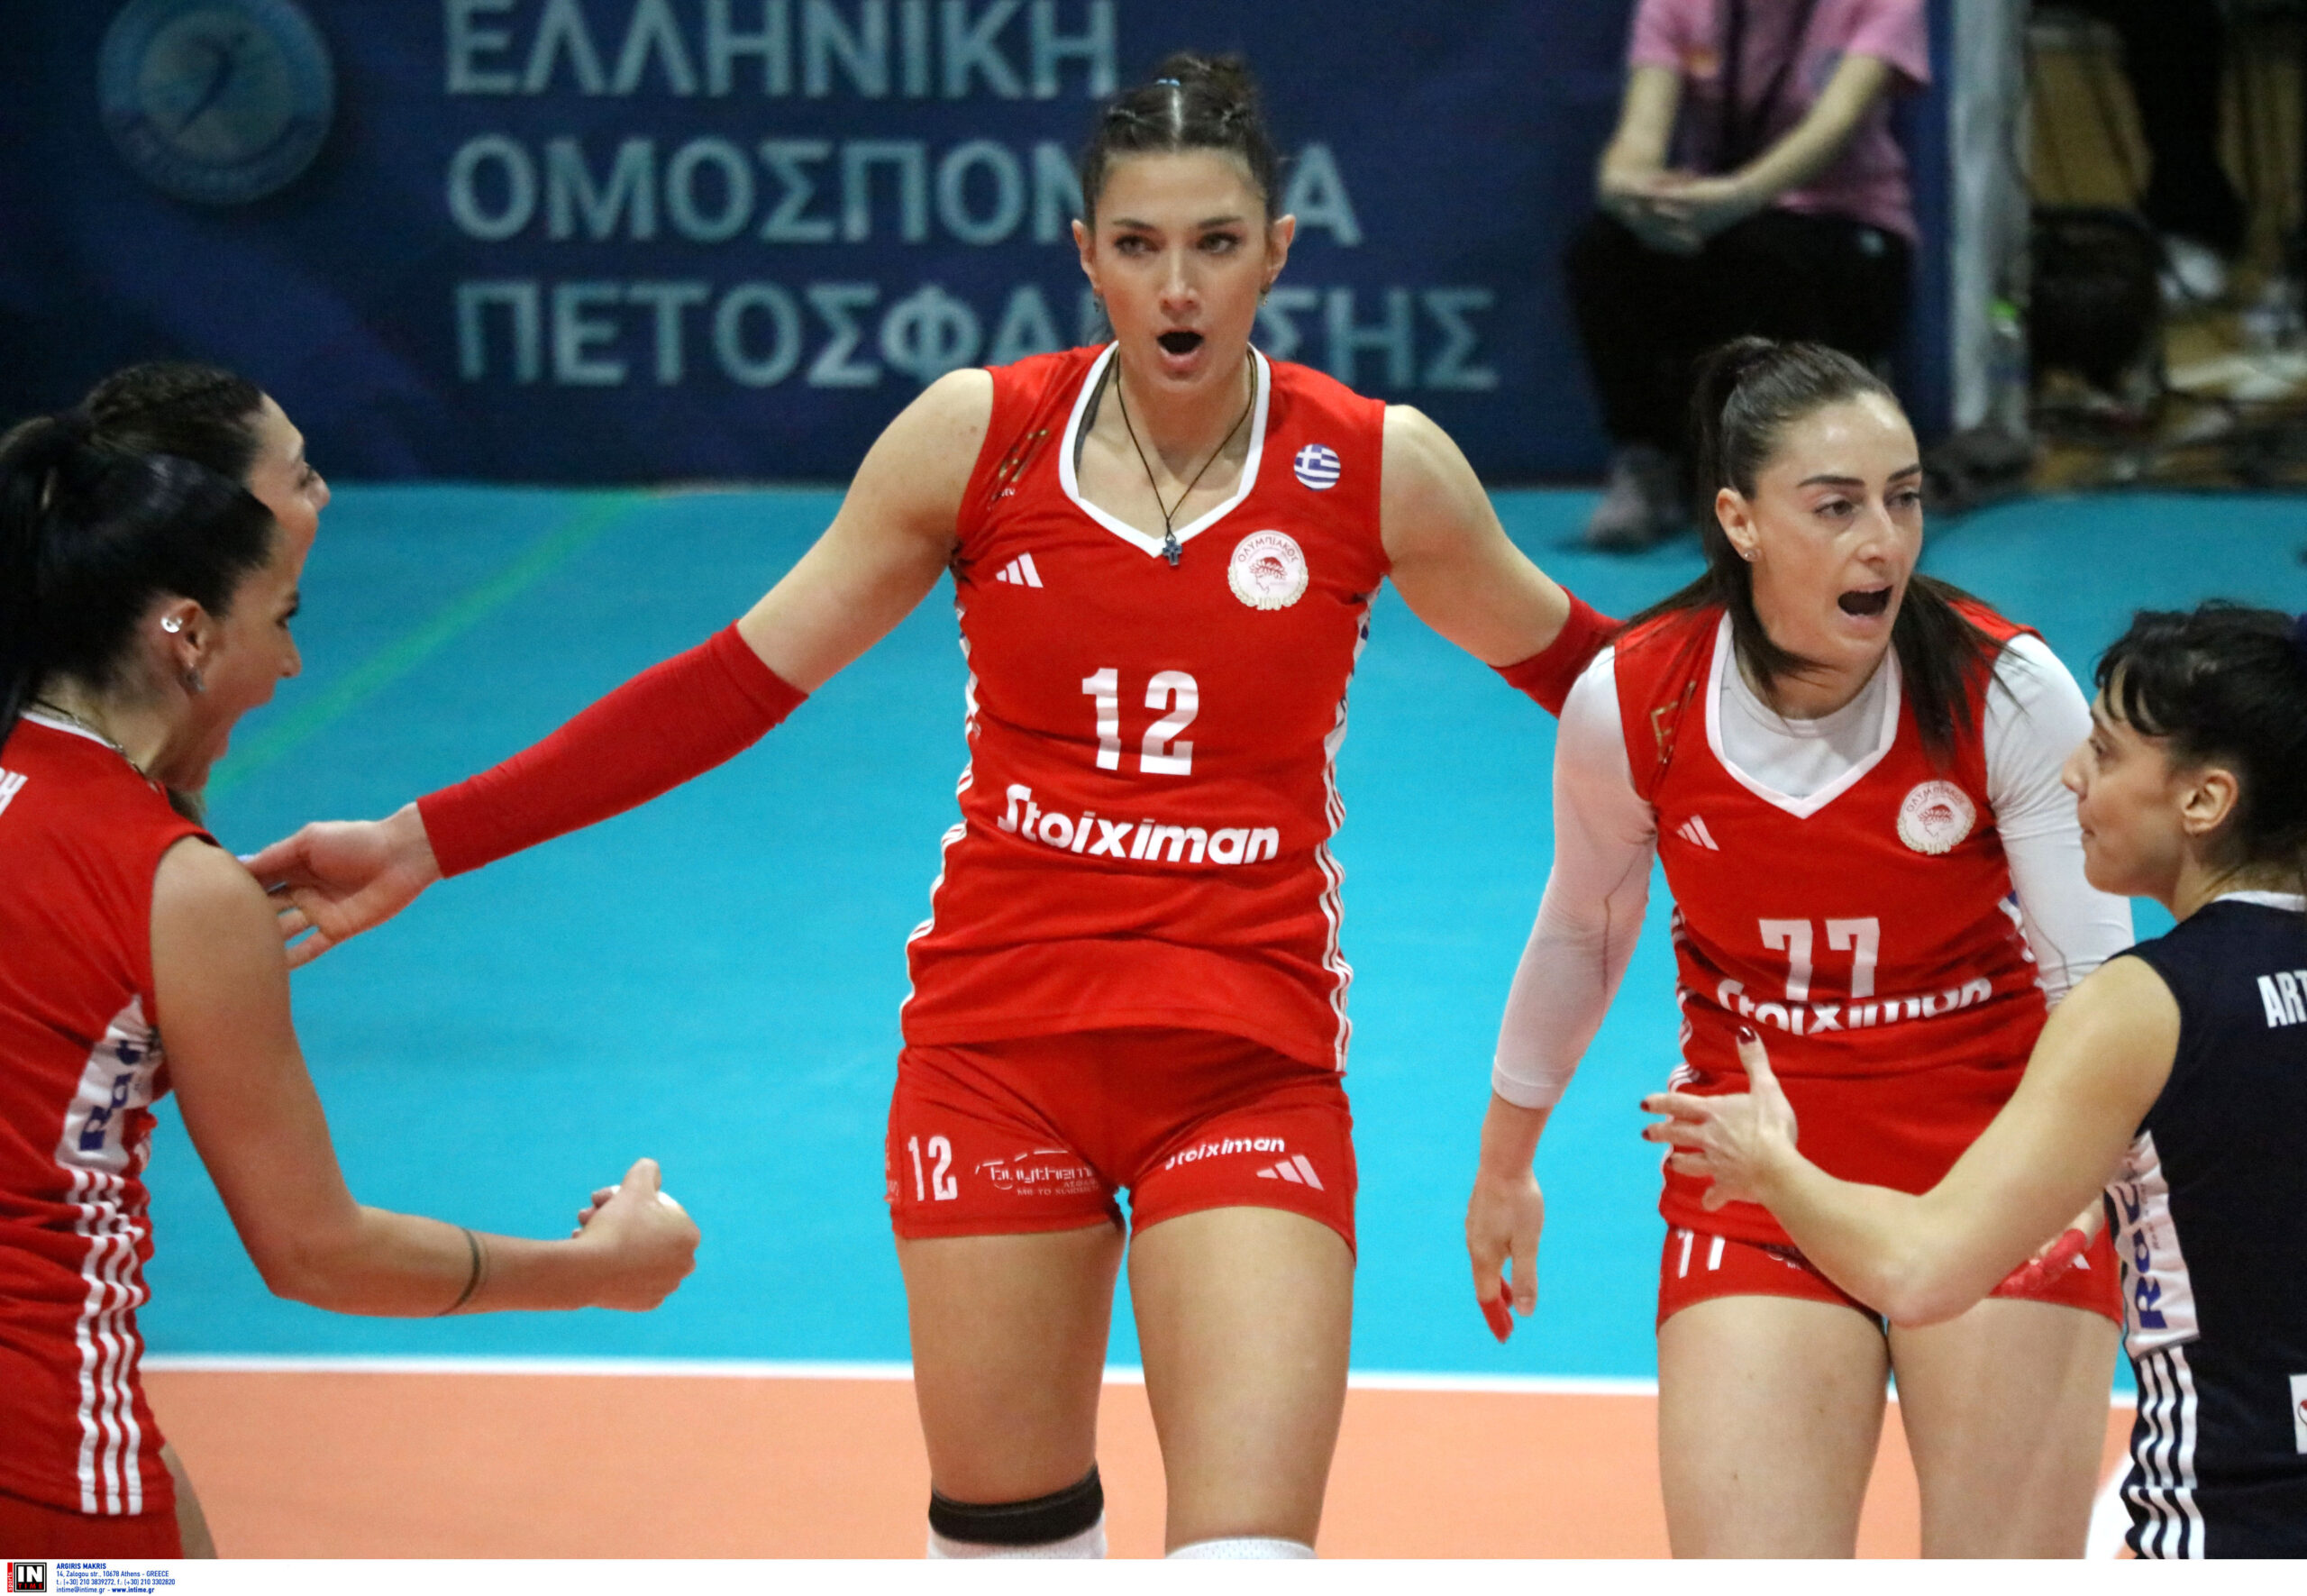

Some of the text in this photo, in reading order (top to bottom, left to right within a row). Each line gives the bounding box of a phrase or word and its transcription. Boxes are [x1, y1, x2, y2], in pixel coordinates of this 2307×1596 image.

[449, 136, 1363, 247] ΟΜΟΣΠΟΝΑ
[1081, 667, 1199, 776] 12
[998, 783, 1280, 865] Stoiximan
[1758, 917, 1881, 1001] 77
[907, 1135, 958, 1201] 12
